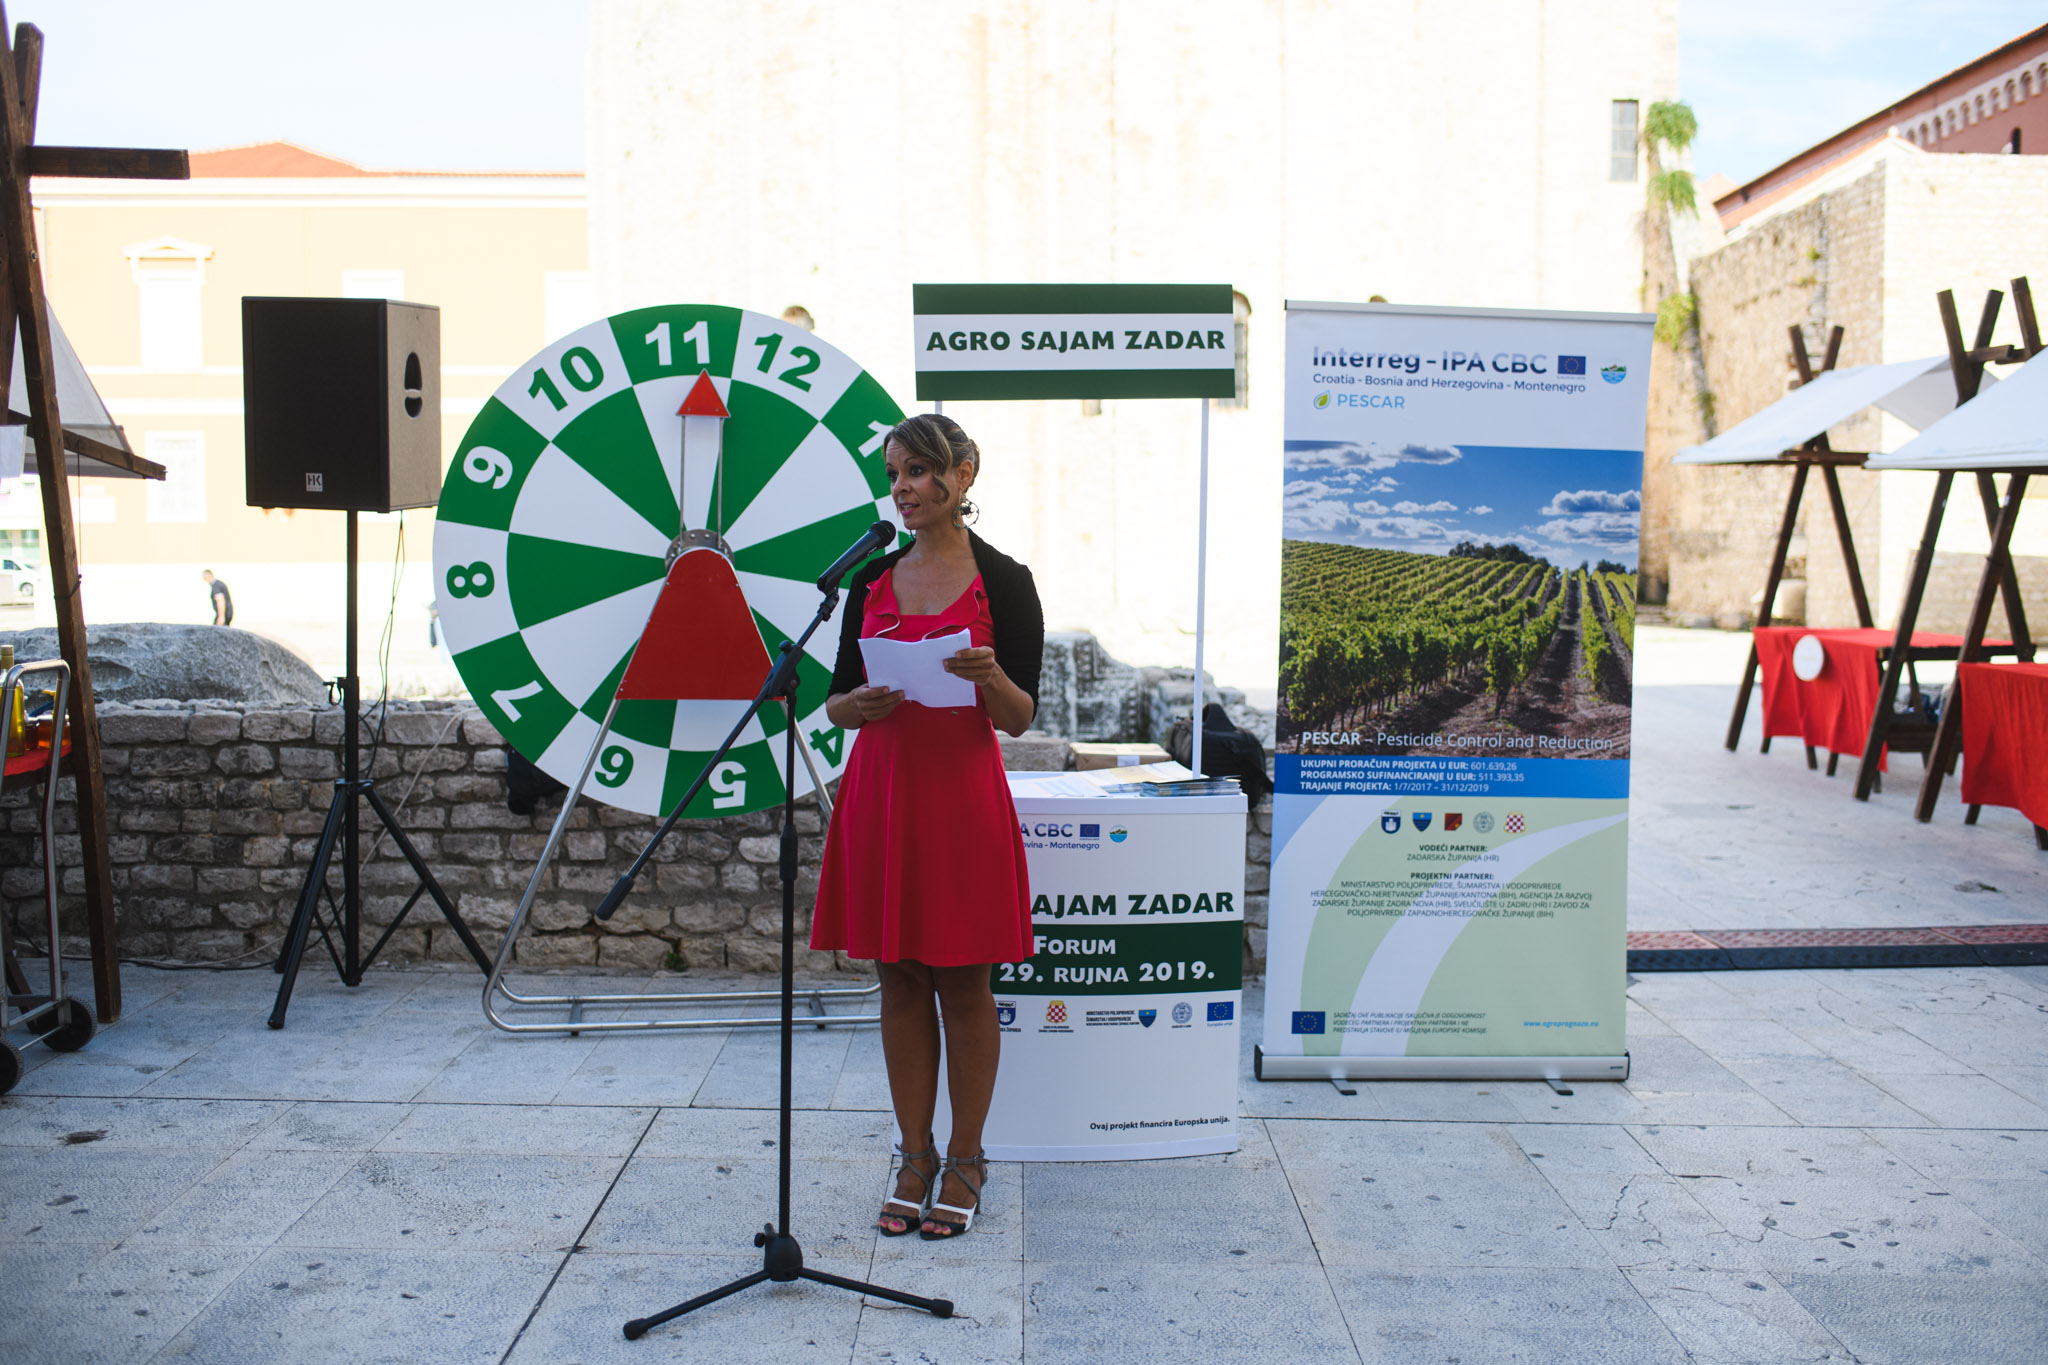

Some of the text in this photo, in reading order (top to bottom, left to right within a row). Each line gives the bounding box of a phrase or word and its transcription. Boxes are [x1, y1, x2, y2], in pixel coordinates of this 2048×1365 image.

[645, 321, 710, 366] 11
[926, 330, 1226, 353] AGRO SAJAM ZADAR
[753, 332, 821, 392] 12
[1313, 346, 1420, 374] Interreg
[1442, 351, 1486, 372] IPA
[1492, 352, 1548, 374] CBC
[527, 346, 605, 412] 10
[1313, 373, 1355, 385] Croatia
[1365, 375, 1403, 387] Bosnia
[1406, 377, 1428, 388] and
[1431, 378, 1504, 392] Herzegovina
[1514, 380, 1586, 395] Montenegro
[1337, 394, 1405, 409] PESCAR
[463, 445, 513, 490] 9
[446, 561, 496, 599] 8
[490, 680, 544, 724] 7
[809, 726, 845, 769] 4
[1301, 731, 1361, 746] PESCAR
[1377, 732, 1443, 746] Pesticide
[1447, 733, 1502, 748] Control
[1505, 735, 1534, 749] and
[1539, 735, 1613, 750] Reduction
[1301, 760, 1337, 768] UKUPNI
[1340, 758, 1390, 769] PRORAČUN
[1392, 760, 1437, 771] PROJEKTA
[1439, 761, 1446, 769] U
[1448, 761, 1469, 770] EUR:
[708, 760, 748, 809] 5
[1300, 770, 1365, 780] PROGRAMSKO
[1366, 771, 1445, 782] SUFINANCIRANJE
[1446, 772, 1454, 781] U
[1456, 773, 1477, 781] EUR:
[1300, 781, 1342, 792] TRAJANJE
[1344, 782, 1392, 792] PROJEKTA:
[1394, 783, 1432, 791] 1/7/2017
[1441, 783, 1489, 792] 31/12/2019
[1034, 823, 1073, 837] CBC
[1050, 841, 1100, 851] Montenegro
[1450, 844, 1488, 853] PARTNER:
[1447, 852, 1483, 863] ŽUPANIJA
[1411, 872, 1494, 881] PROJEKTNI PARTNERI:
[1031, 892, 1234, 918] AJAM ZADAR
[999, 963, 1044, 982] 29.
[1139, 961, 1215, 982] 2019.
[1090, 1115, 1230, 1131] Ovaj projekt financira Europska unija.
